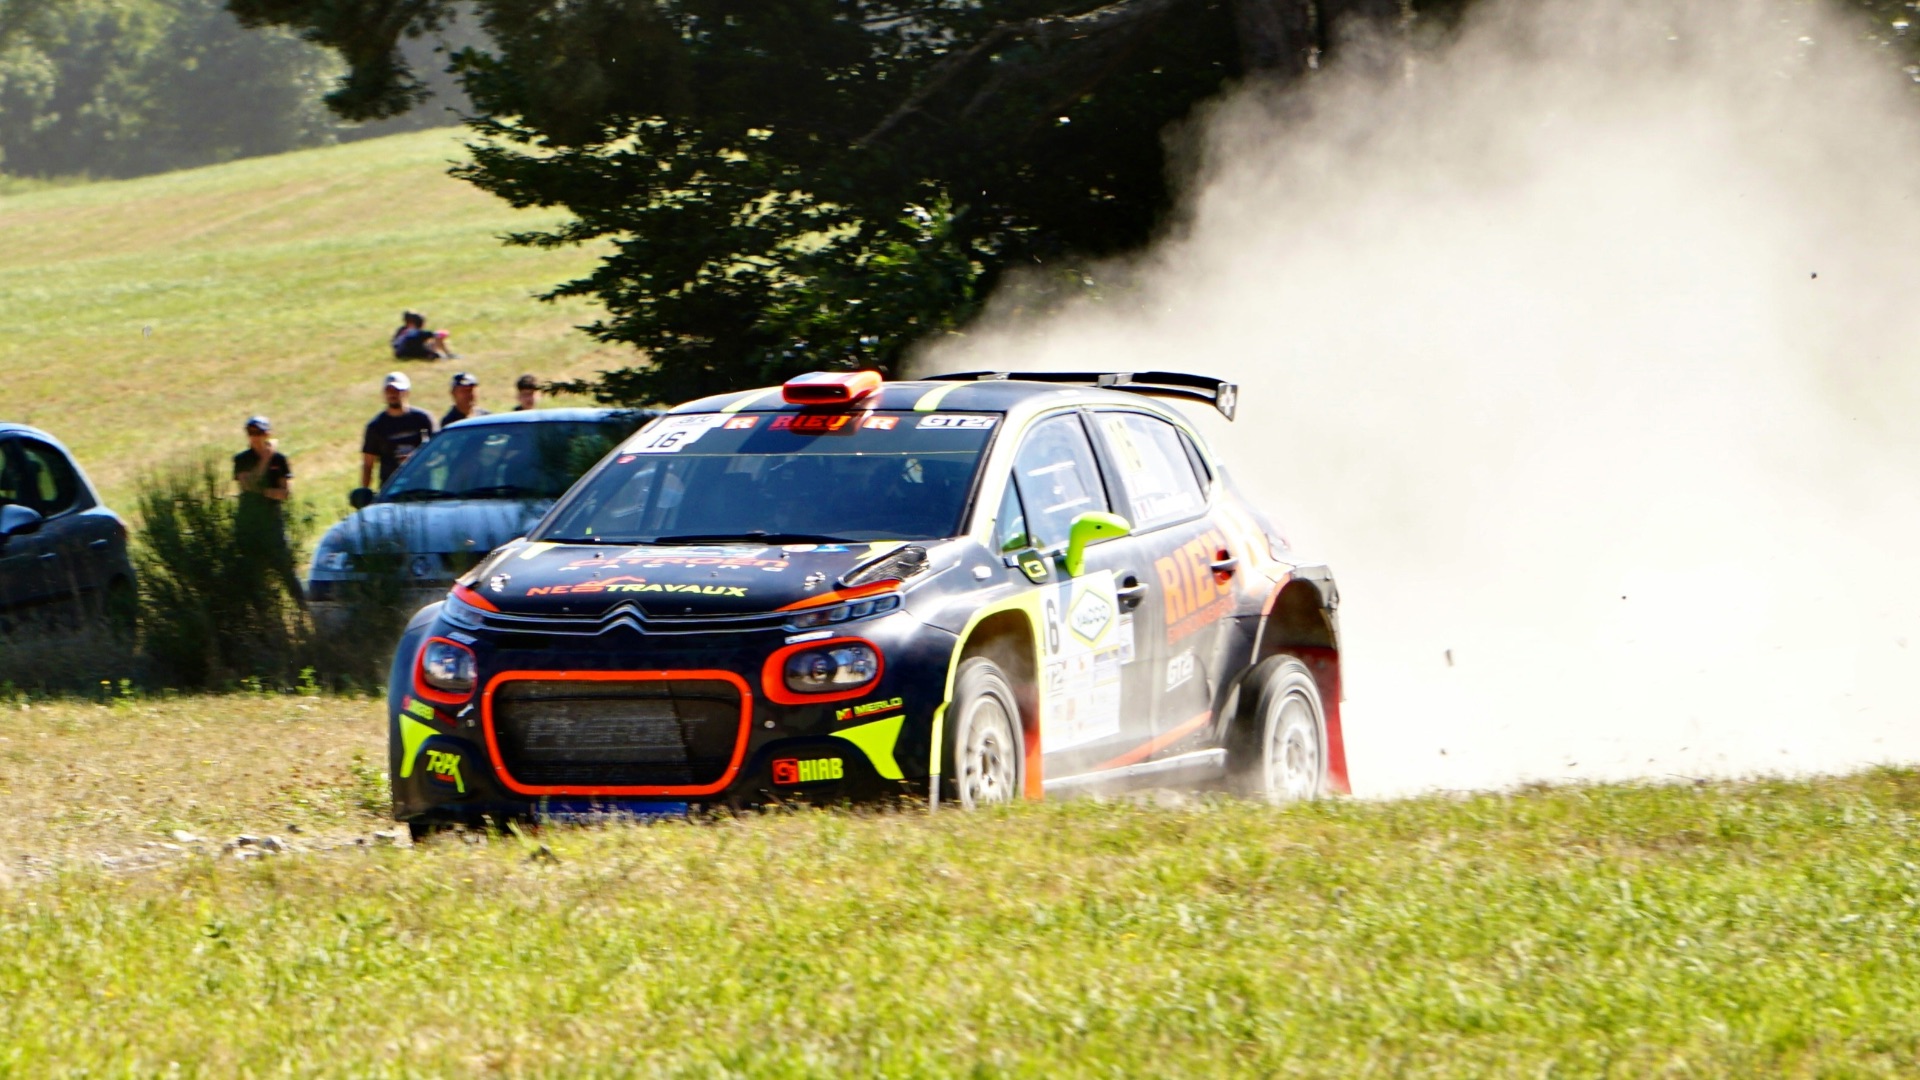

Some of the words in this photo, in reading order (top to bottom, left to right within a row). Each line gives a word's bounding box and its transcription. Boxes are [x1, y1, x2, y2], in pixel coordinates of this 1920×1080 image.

[769, 415, 851, 431] RIEU
[646, 431, 687, 449] 16
[799, 758, 844, 782] HIAB
